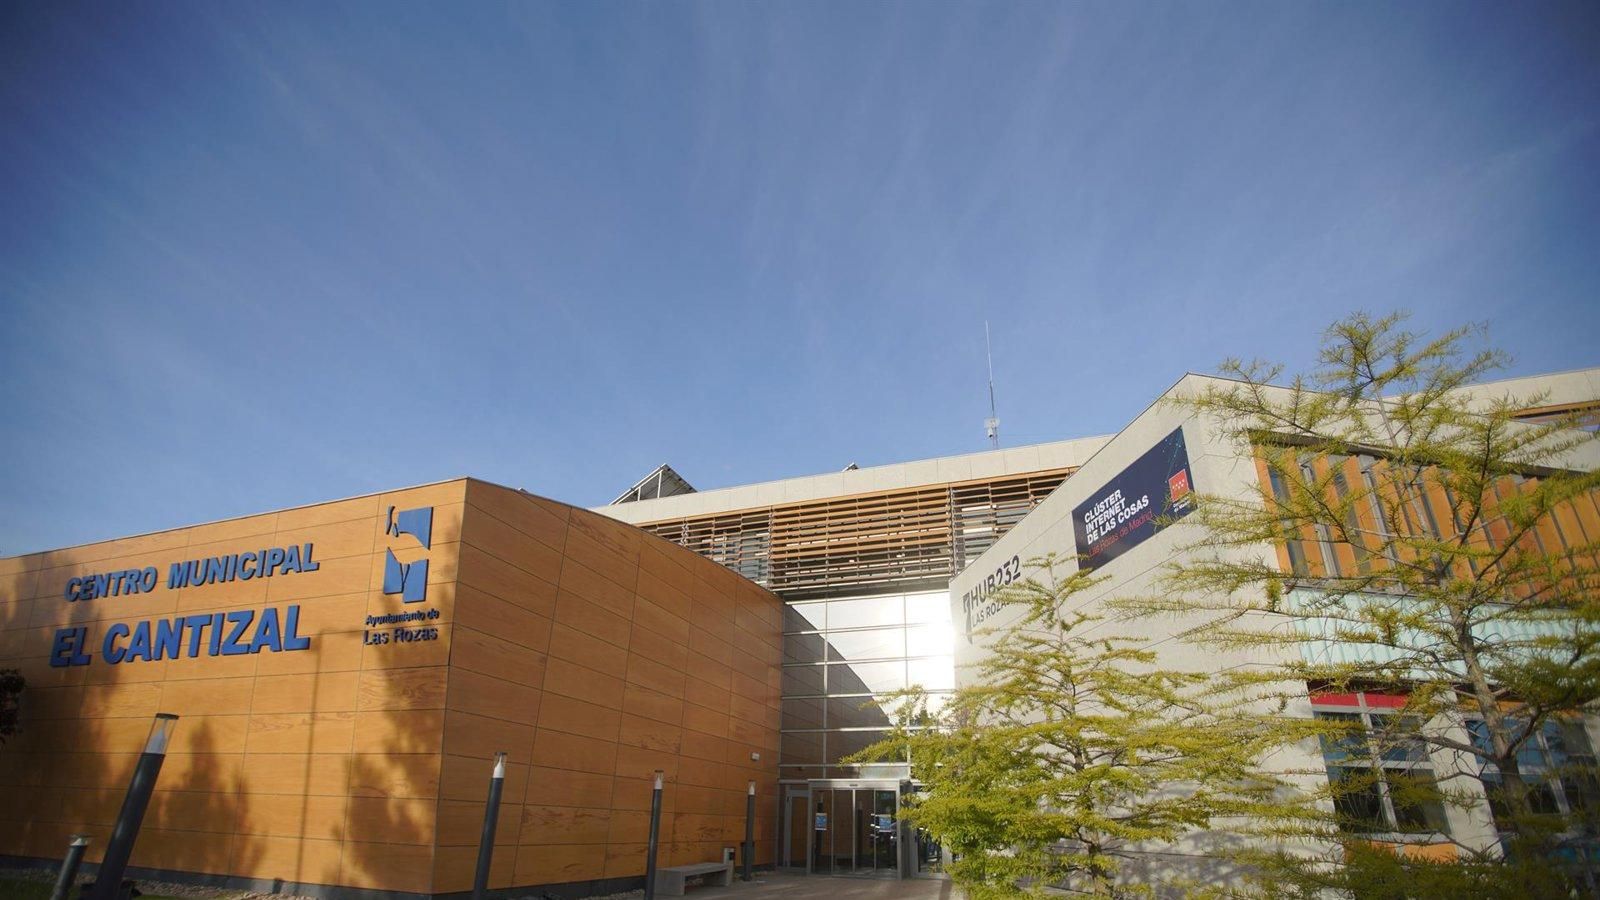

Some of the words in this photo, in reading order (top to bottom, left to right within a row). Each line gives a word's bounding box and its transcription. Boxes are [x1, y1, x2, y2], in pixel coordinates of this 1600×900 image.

[1084, 489, 1122, 523] CLÚSTER
[1085, 498, 1126, 534] INTERNET
[1087, 529, 1099, 545] DE
[1100, 517, 1117, 537] LAS
[1117, 494, 1149, 524] COSAS
[64, 566, 158, 602] CENTRO
[167, 543, 320, 589] MUNICIPAL
[366, 611, 426, 627] Ayuntamiento
[427, 608, 439, 619] de
[971, 610, 985, 628] LAS
[986, 598, 1009, 619] ROZA
[49, 627, 92, 668] EL
[102, 605, 311, 666] CANTIZAL
[364, 630, 389, 645] Las
[394, 627, 438, 643] Rozas
